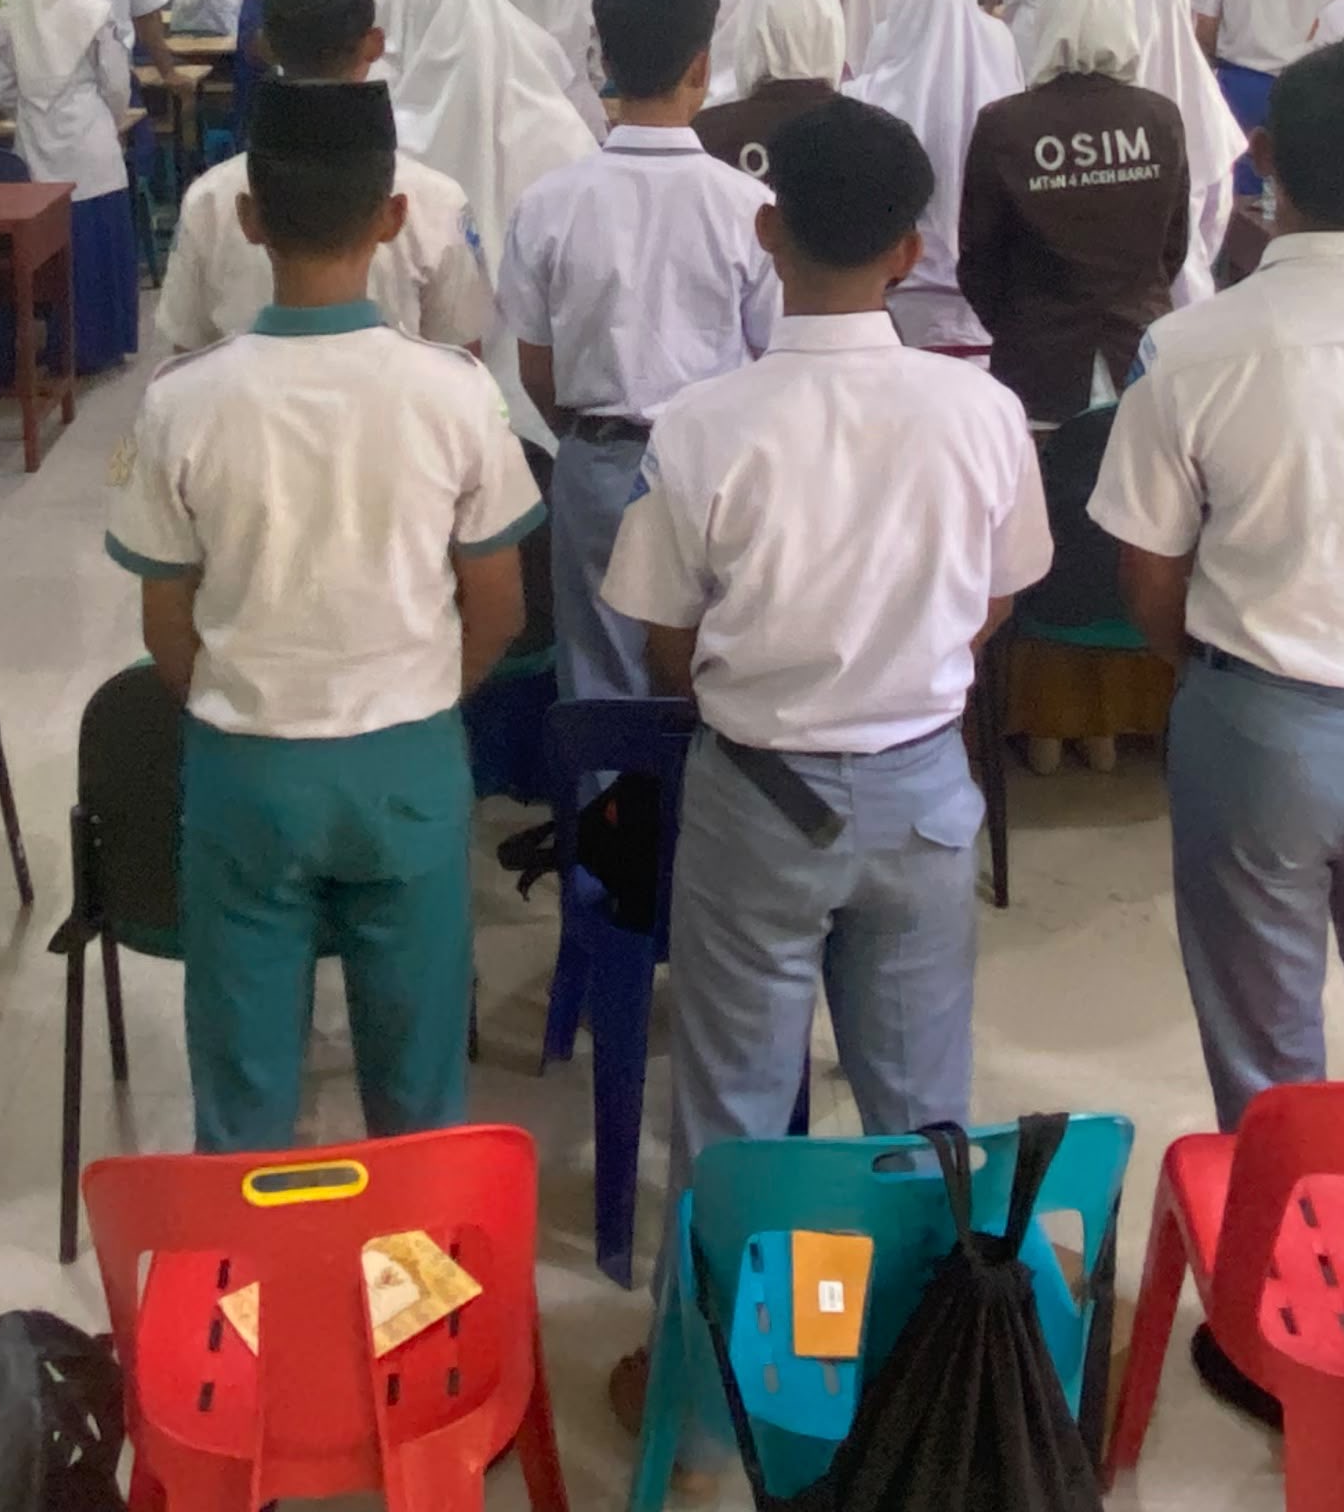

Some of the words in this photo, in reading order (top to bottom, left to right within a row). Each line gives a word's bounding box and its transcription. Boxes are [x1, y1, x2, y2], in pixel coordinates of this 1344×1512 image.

[1034, 125, 1151, 172] OSIM
[1080, 170, 1116, 187] ACEH
[1117, 164, 1161, 184] BARAT
